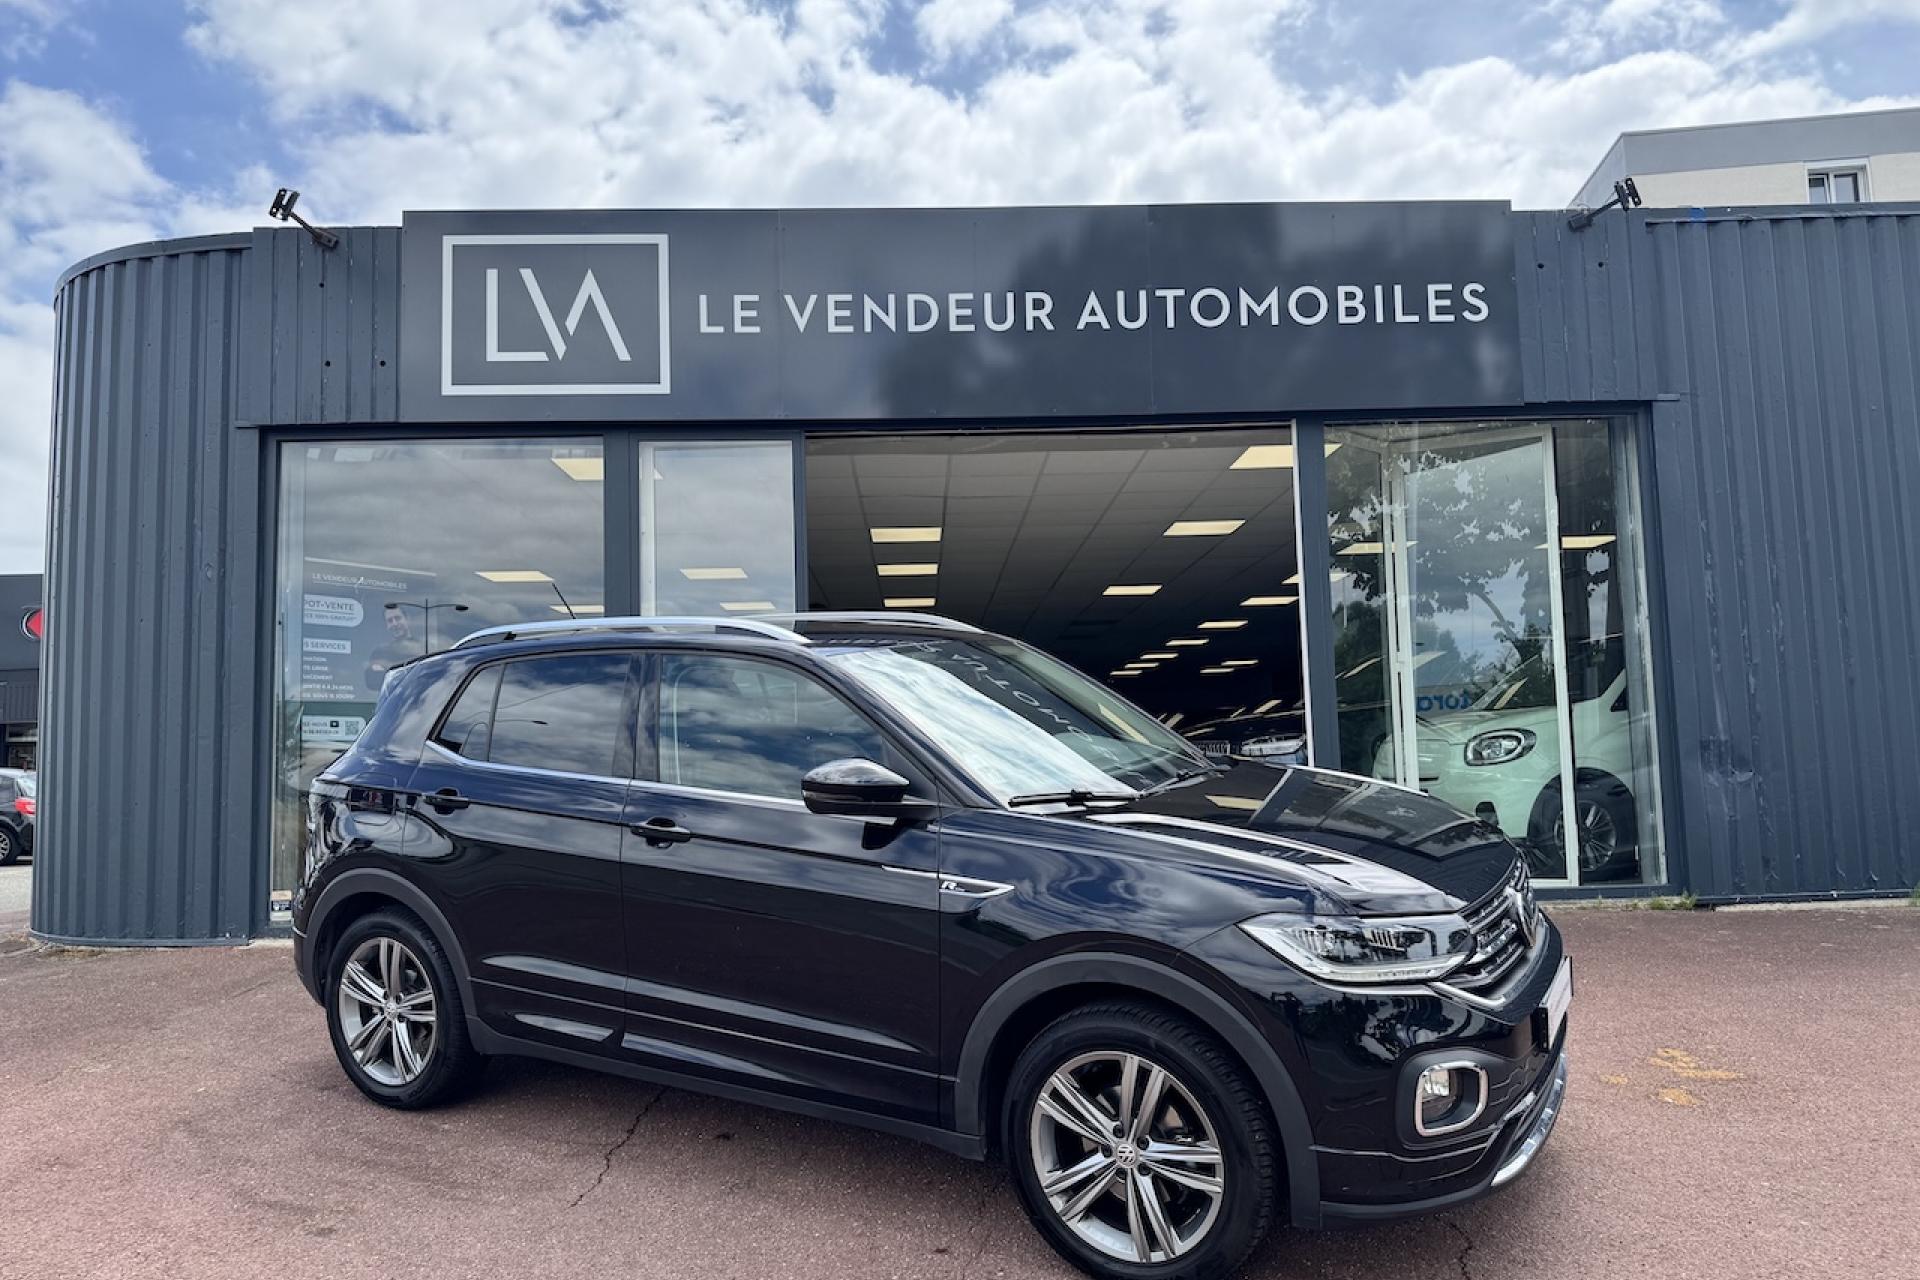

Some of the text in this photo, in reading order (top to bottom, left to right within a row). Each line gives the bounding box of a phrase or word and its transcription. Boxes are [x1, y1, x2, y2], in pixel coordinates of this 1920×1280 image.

[699, 282, 1489, 333] LE VENDEUR AUTOMOBILES
